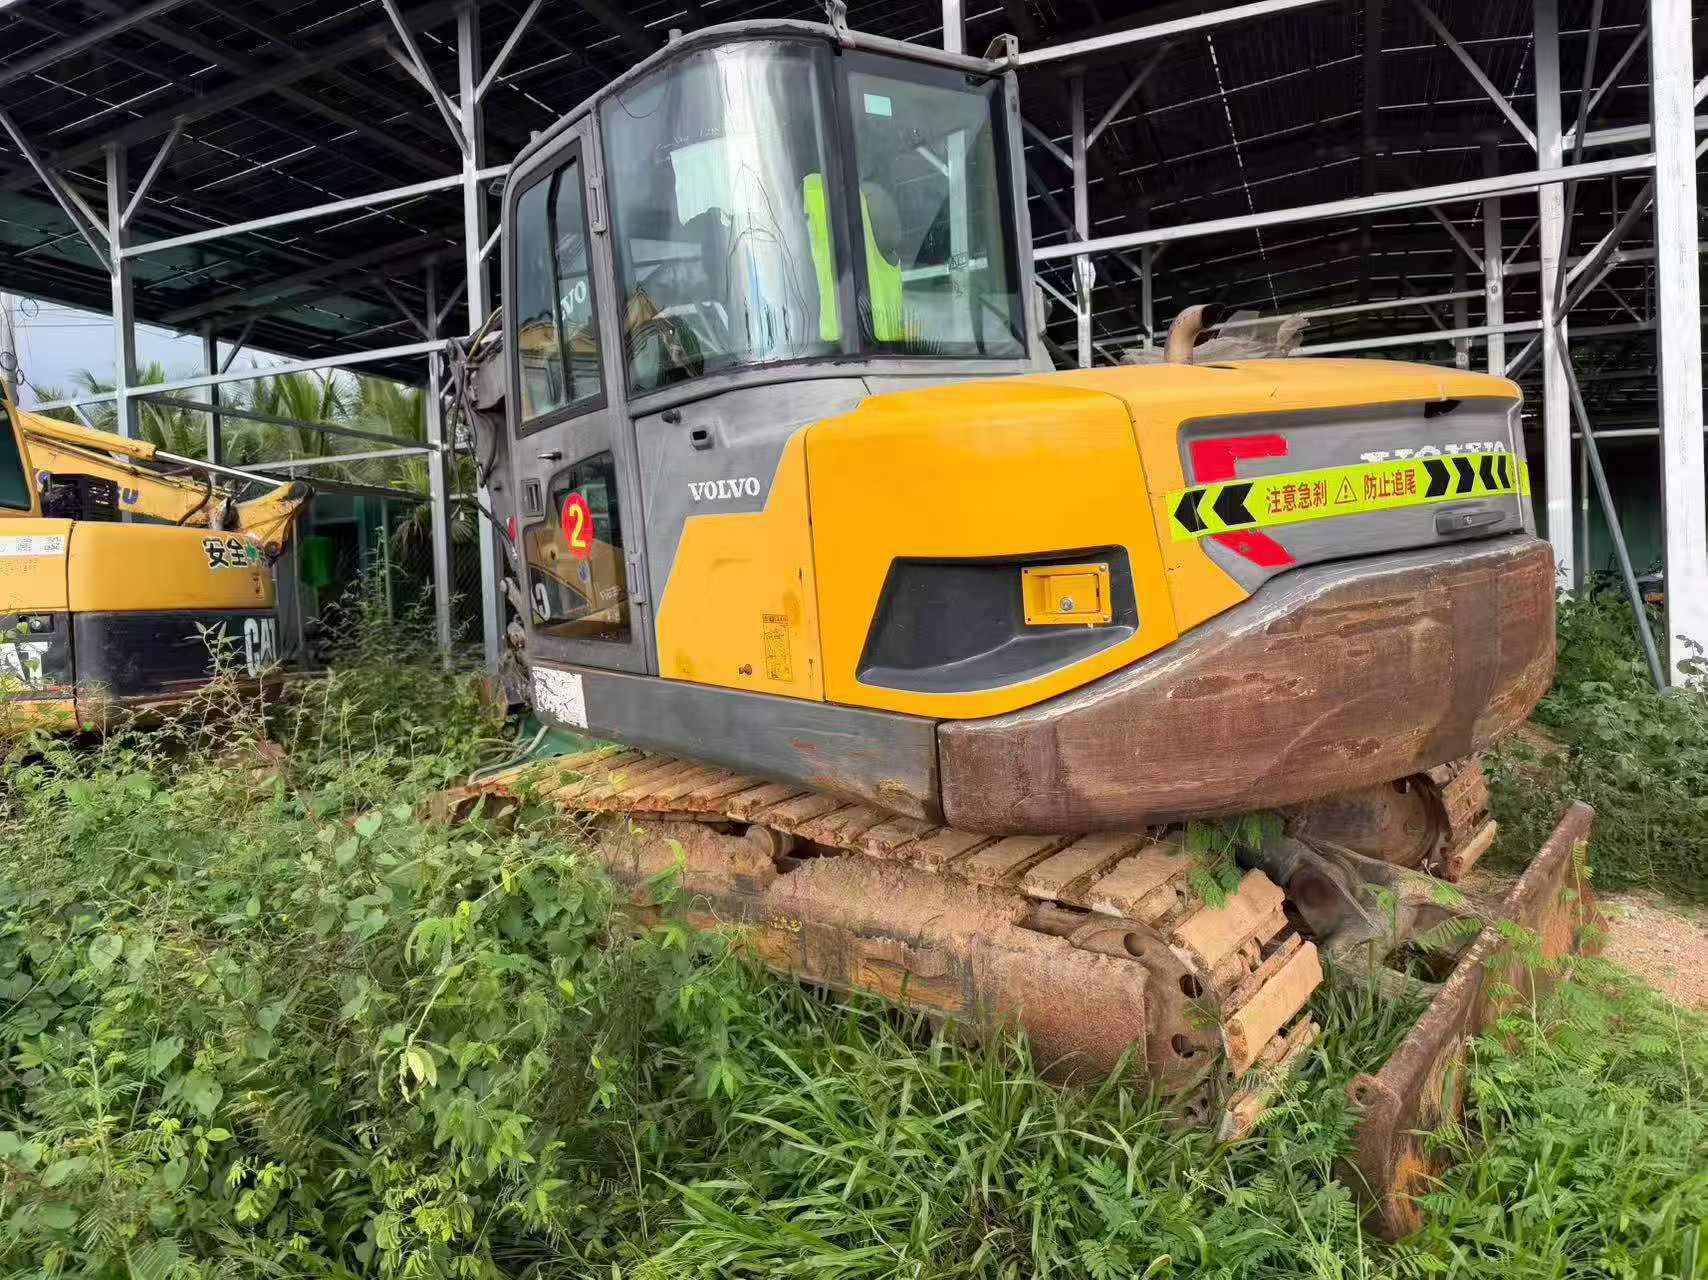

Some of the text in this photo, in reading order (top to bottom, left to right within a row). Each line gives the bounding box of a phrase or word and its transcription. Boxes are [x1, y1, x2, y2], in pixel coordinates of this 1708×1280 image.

[687, 477, 761, 501] VOLVO
[1266, 468, 1417, 514] 注意急刹 防止追尾
[569, 504, 586, 548] 2
[202, 535, 248, 569] 安全
